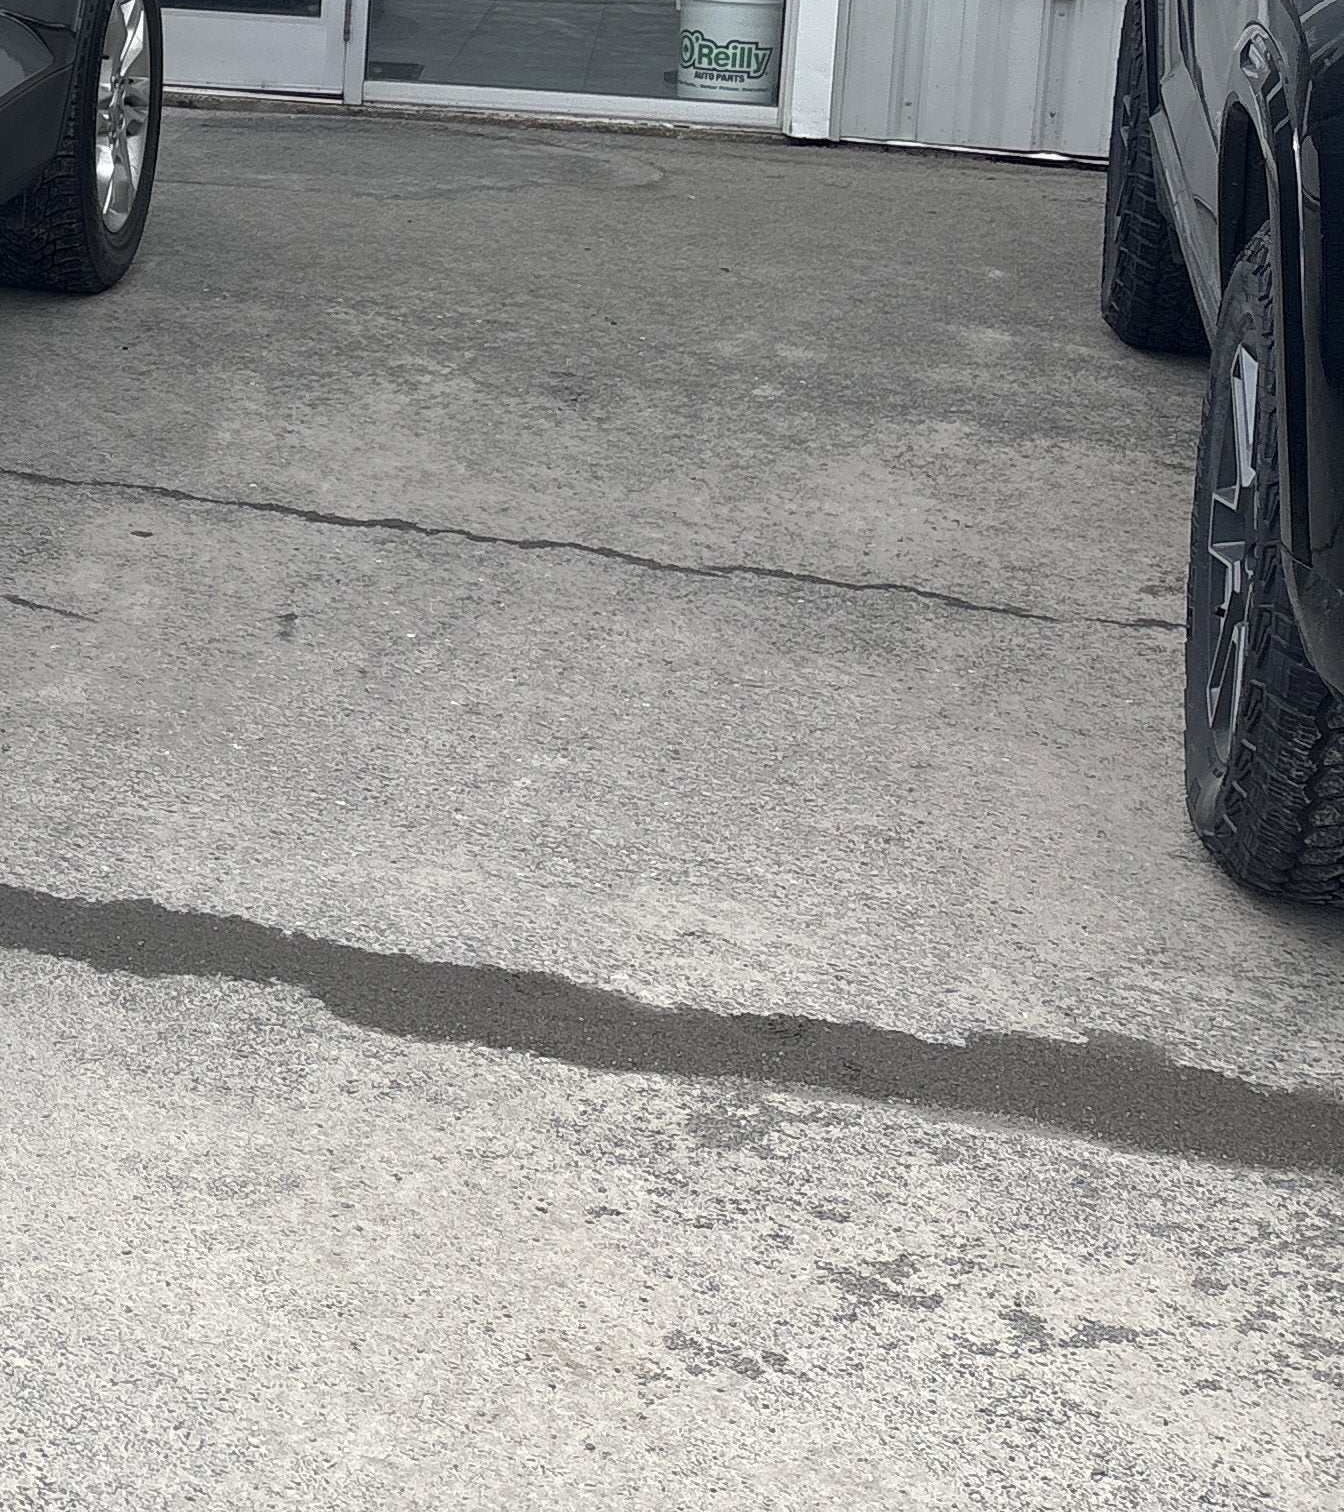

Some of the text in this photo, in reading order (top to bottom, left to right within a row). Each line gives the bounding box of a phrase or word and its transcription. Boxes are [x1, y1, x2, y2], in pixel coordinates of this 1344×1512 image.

[680, 33, 768, 75] O'Reilly
[694, 70, 745, 83] AUTO PARTS
